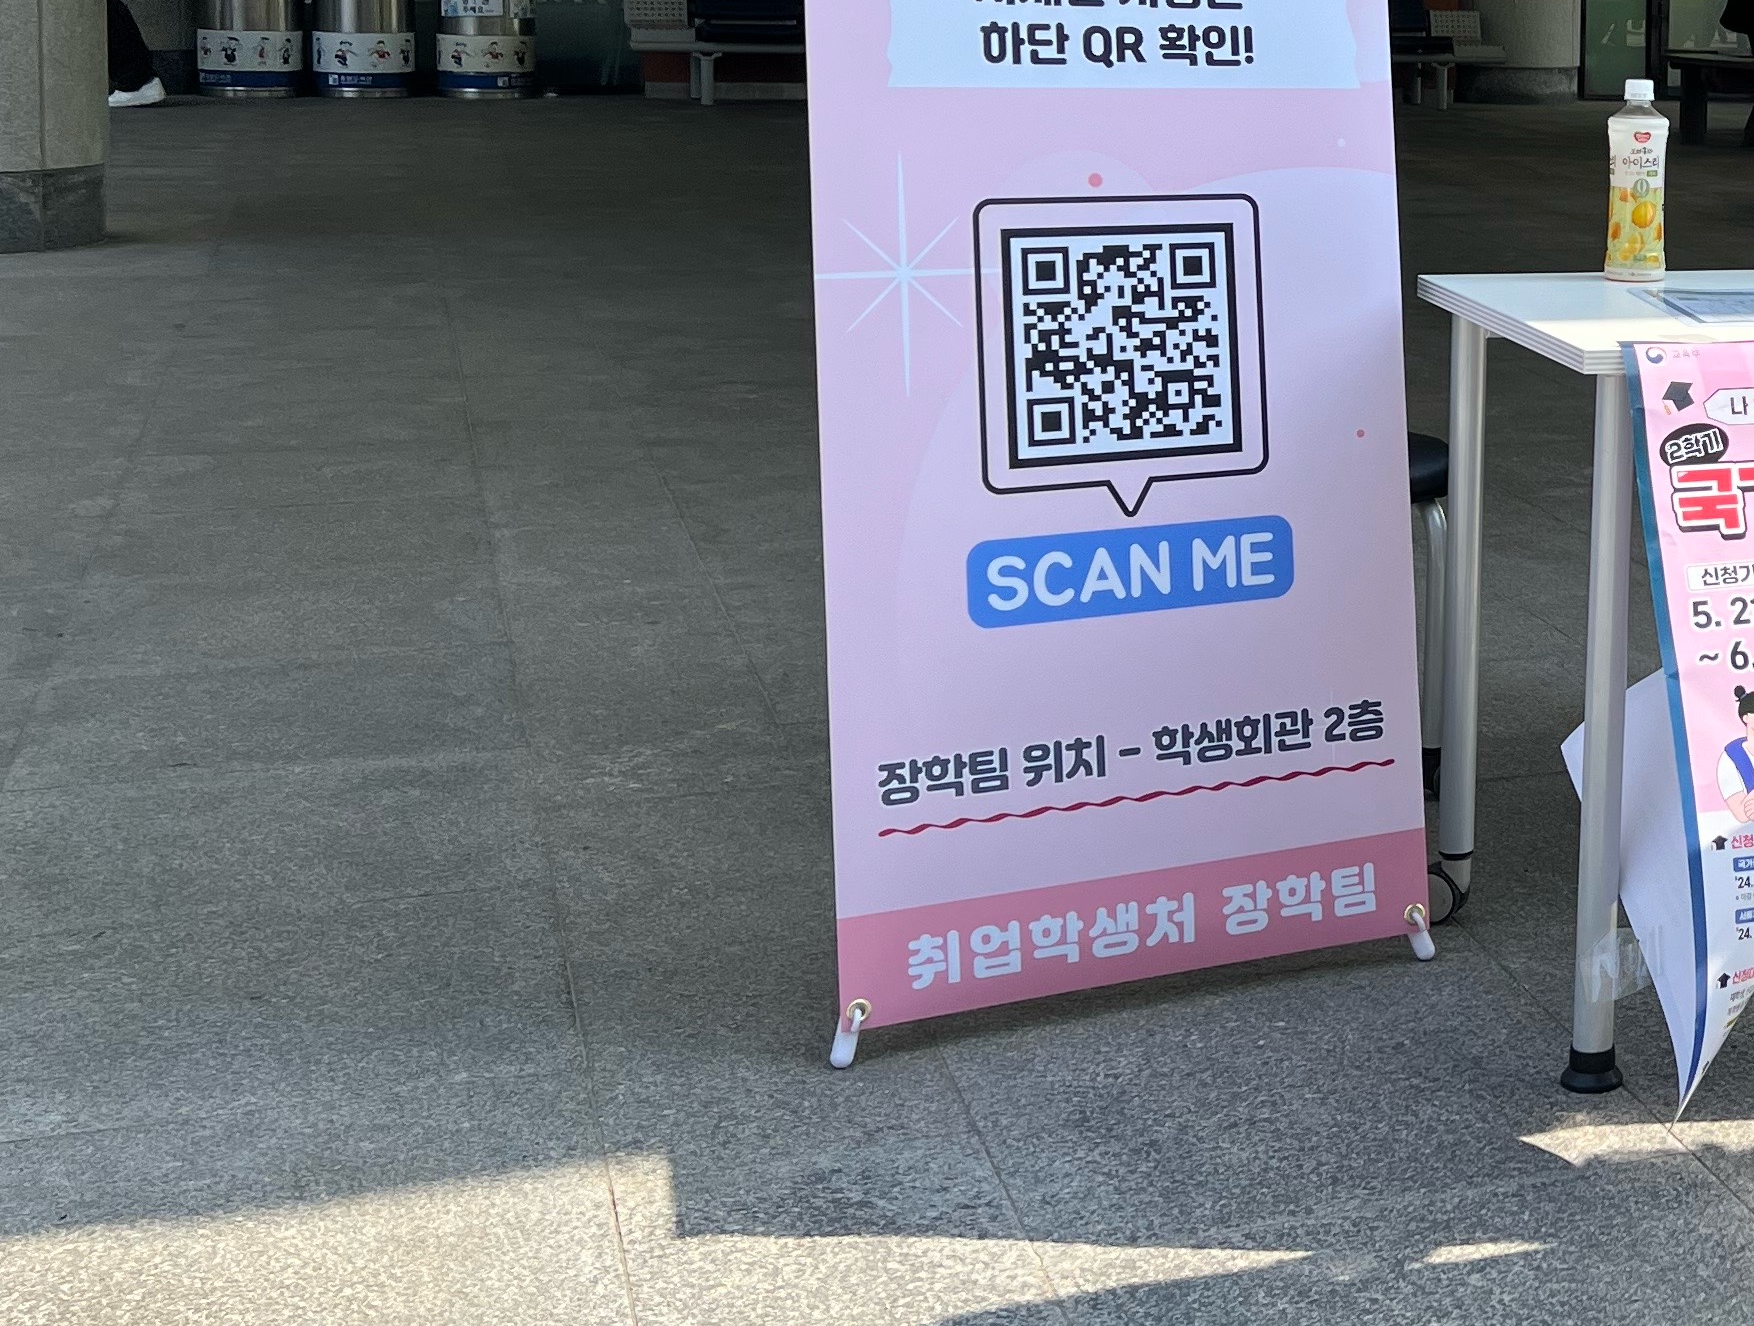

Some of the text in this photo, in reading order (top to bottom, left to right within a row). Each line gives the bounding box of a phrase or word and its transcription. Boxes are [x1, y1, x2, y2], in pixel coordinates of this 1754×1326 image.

[980, 21, 1255, 69] 하단 QR 확인!
[1730, 396, 1748, 416] 나
[1665, 429, 1723, 464] 2학기
[985, 531, 1277, 614] SCAN ME
[1692, 599, 1722, 629] 5.
[877, 748, 1010, 807] 장학팀
[1021, 733, 1107, 787] 위치
[1151, 707, 1314, 767] 학생회관
[1323, 699, 1386, 744] 2층
[907, 861, 1377, 992] 취업학생처 장학팀
